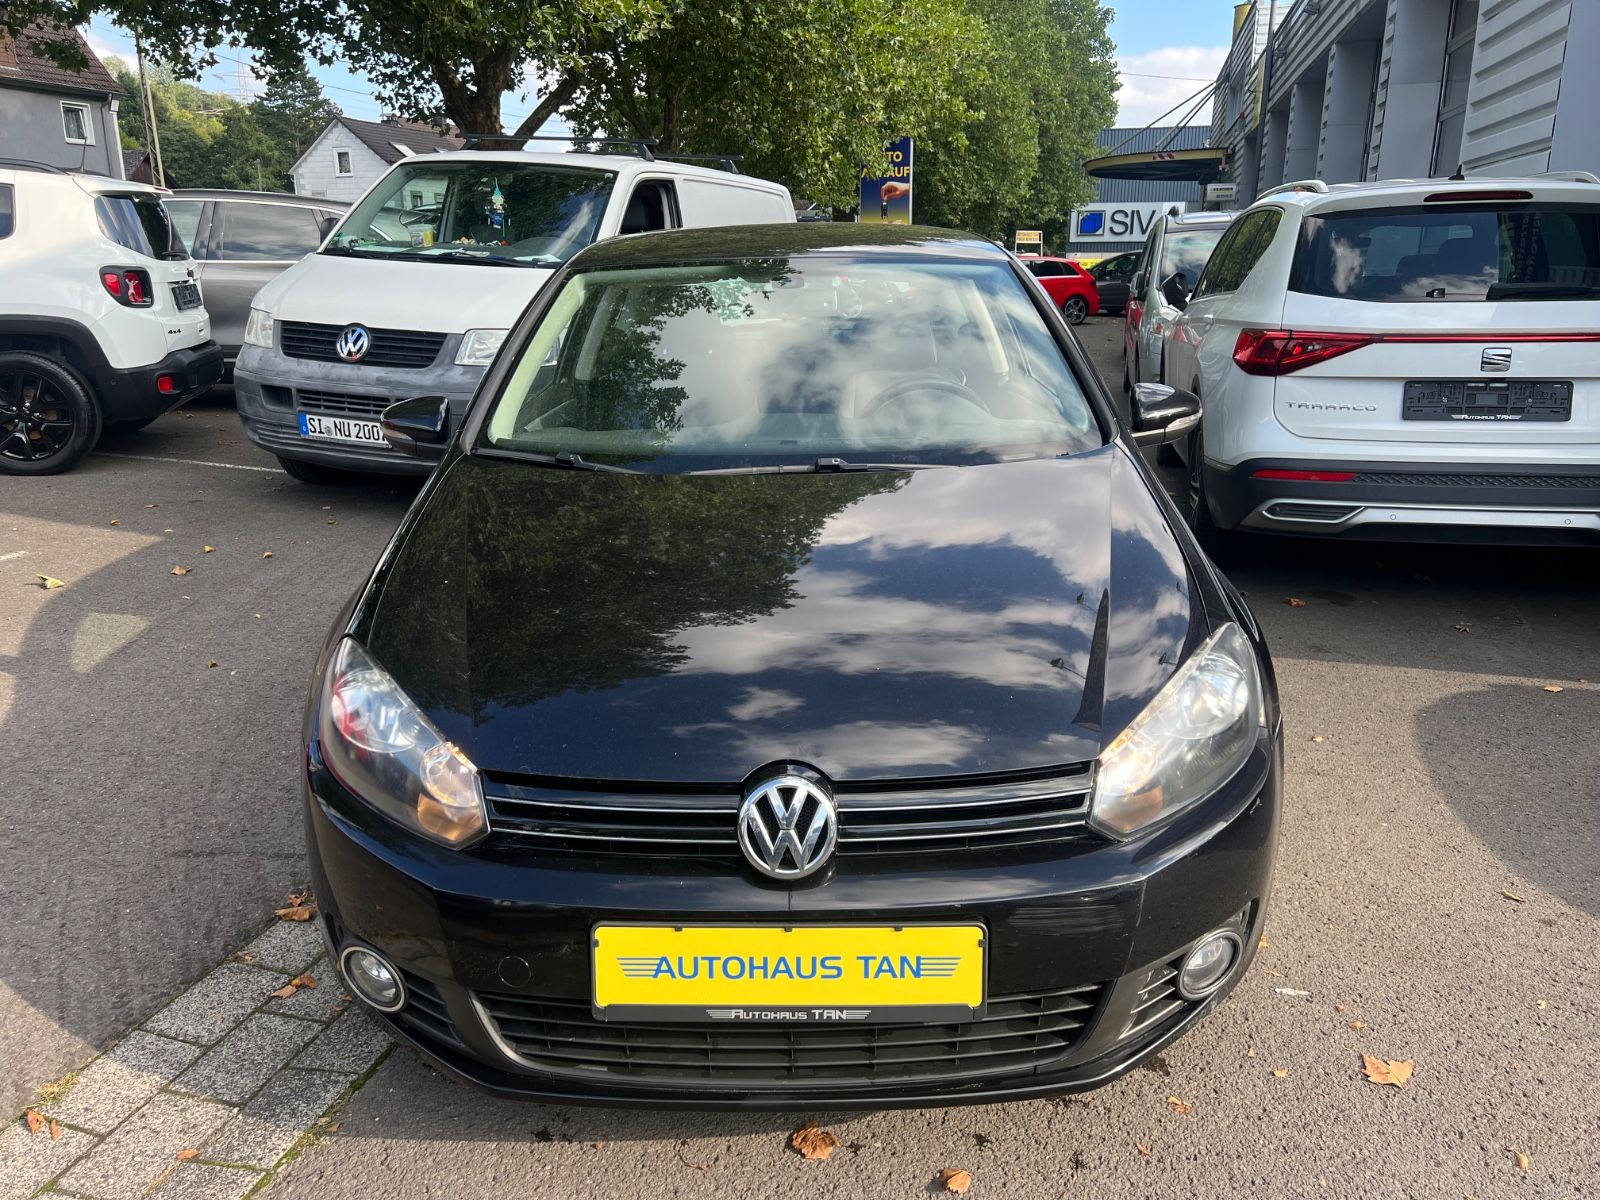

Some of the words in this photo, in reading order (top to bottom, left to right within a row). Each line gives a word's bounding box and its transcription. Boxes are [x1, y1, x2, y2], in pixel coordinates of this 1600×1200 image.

[308, 417, 325, 434] SI
[333, 420, 352, 438] NU
[354, 423, 386, 442] 200
[652, 956, 843, 979] AUTOHAUS
[856, 955, 922, 979] TAN
[811, 1009, 847, 1020] TAN
